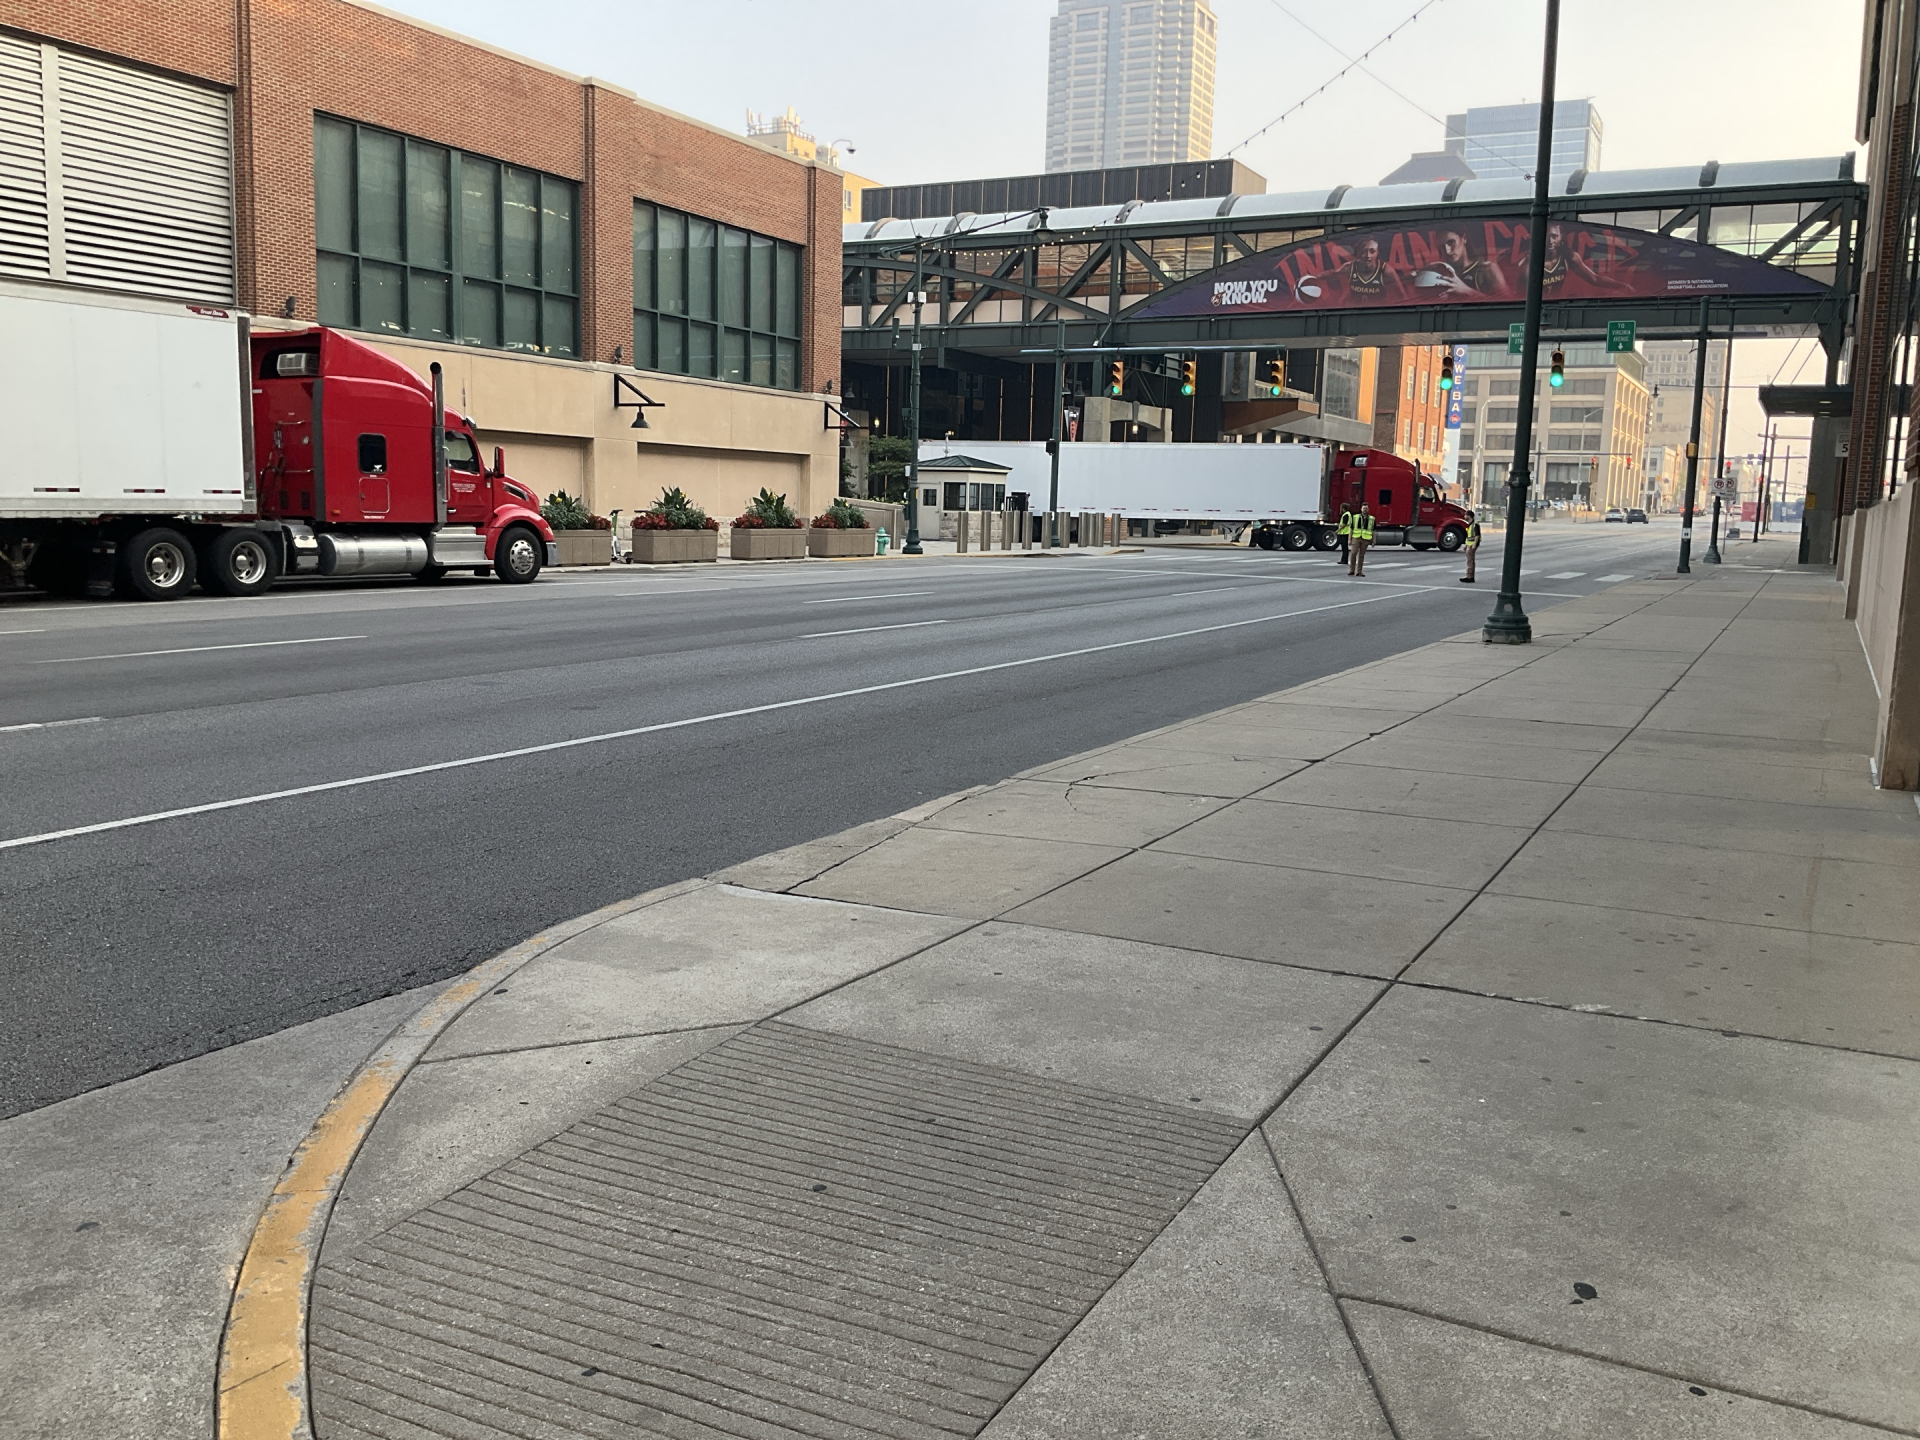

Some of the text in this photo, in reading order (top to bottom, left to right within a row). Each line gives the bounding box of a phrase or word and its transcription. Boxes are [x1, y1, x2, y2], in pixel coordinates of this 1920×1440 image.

[1214, 279, 1278, 295] NOW YOU
[1221, 291, 1267, 305] KNOW.
[1841, 444, 1848, 453] 5
